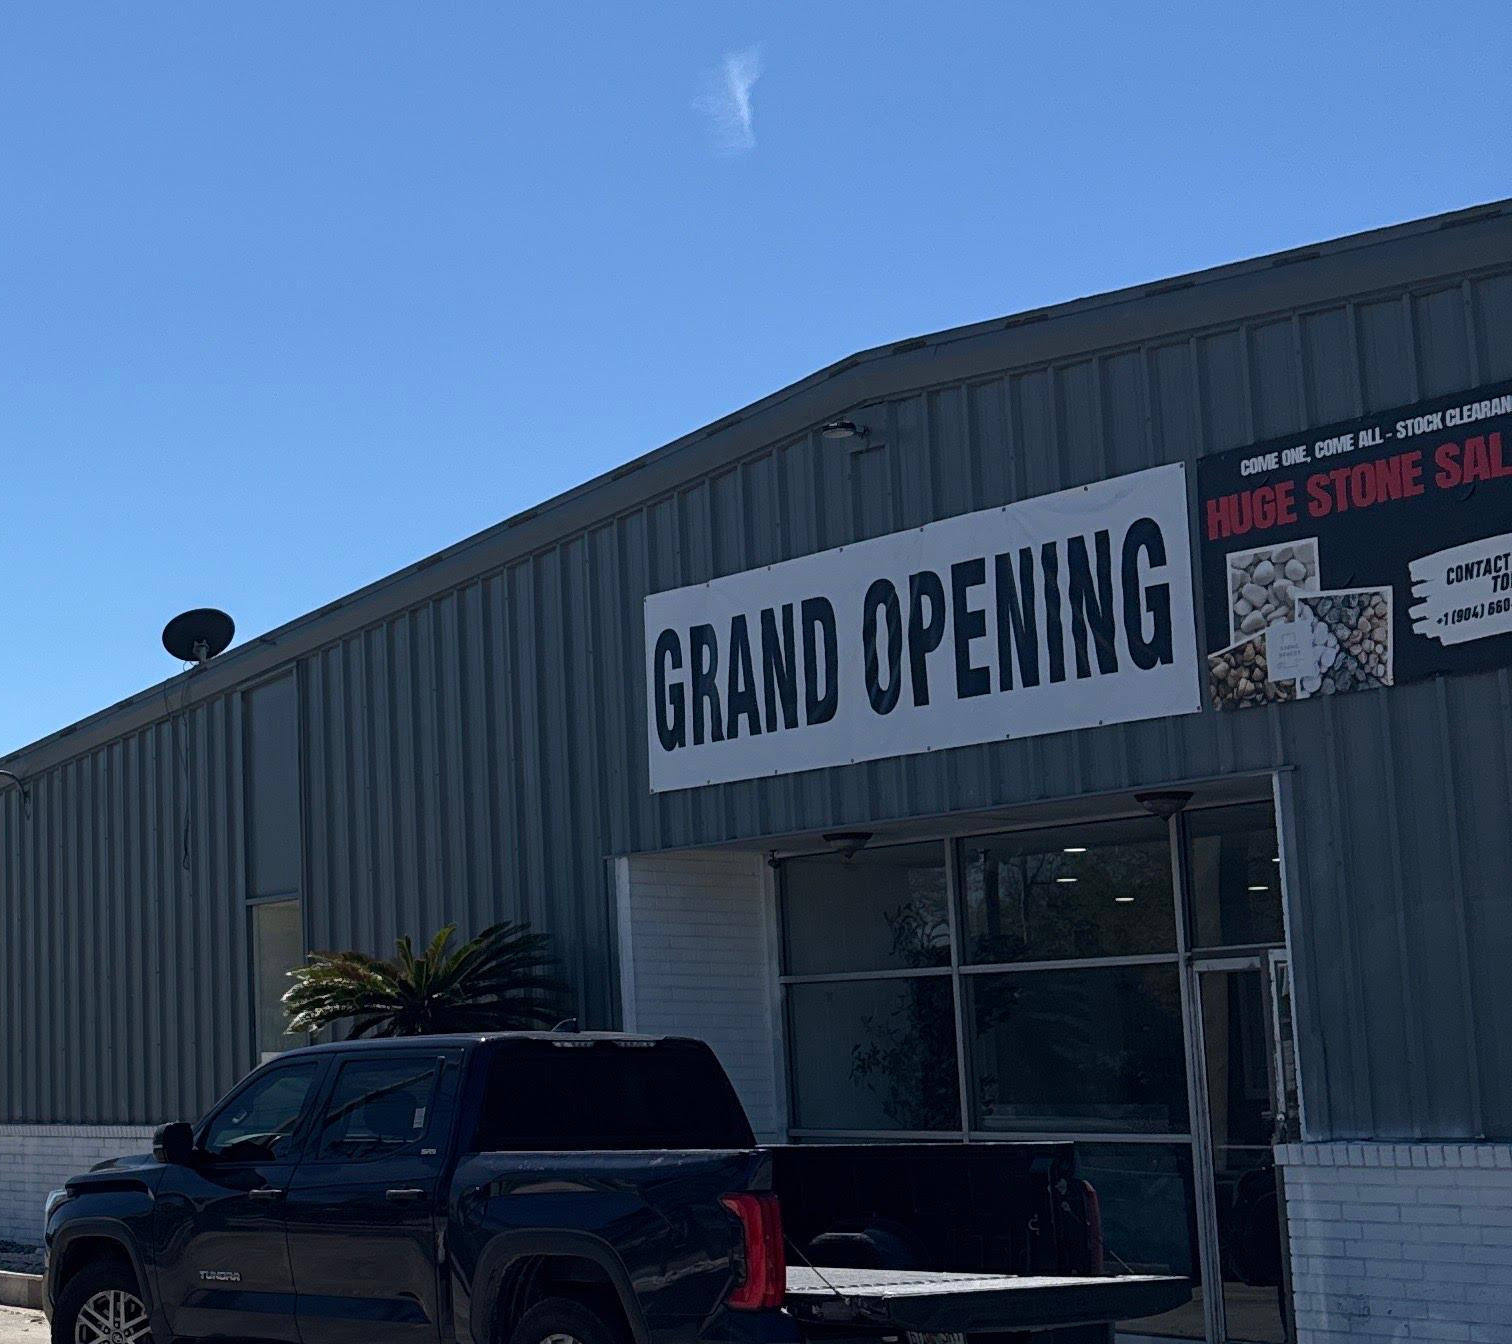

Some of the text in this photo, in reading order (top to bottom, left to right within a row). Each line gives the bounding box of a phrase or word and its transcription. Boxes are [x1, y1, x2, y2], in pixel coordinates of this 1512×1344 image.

[1240, 452, 1279, 477] COME
[1281, 445, 1312, 465] ONE,
[1314, 433, 1355, 458] COME
[1358, 427, 1384, 449] ALL
[1396, 412, 1443, 440] STOCK
[1207, 480, 1298, 541] HUGE
[1307, 450, 1425, 518] STONE
[1446, 551, 1511, 586] CONTACT
[1491, 570, 1512, 593] TO
[654, 517, 1174, 752] GRAND OPENING
[1451, 601, 1485, 625] (904)
